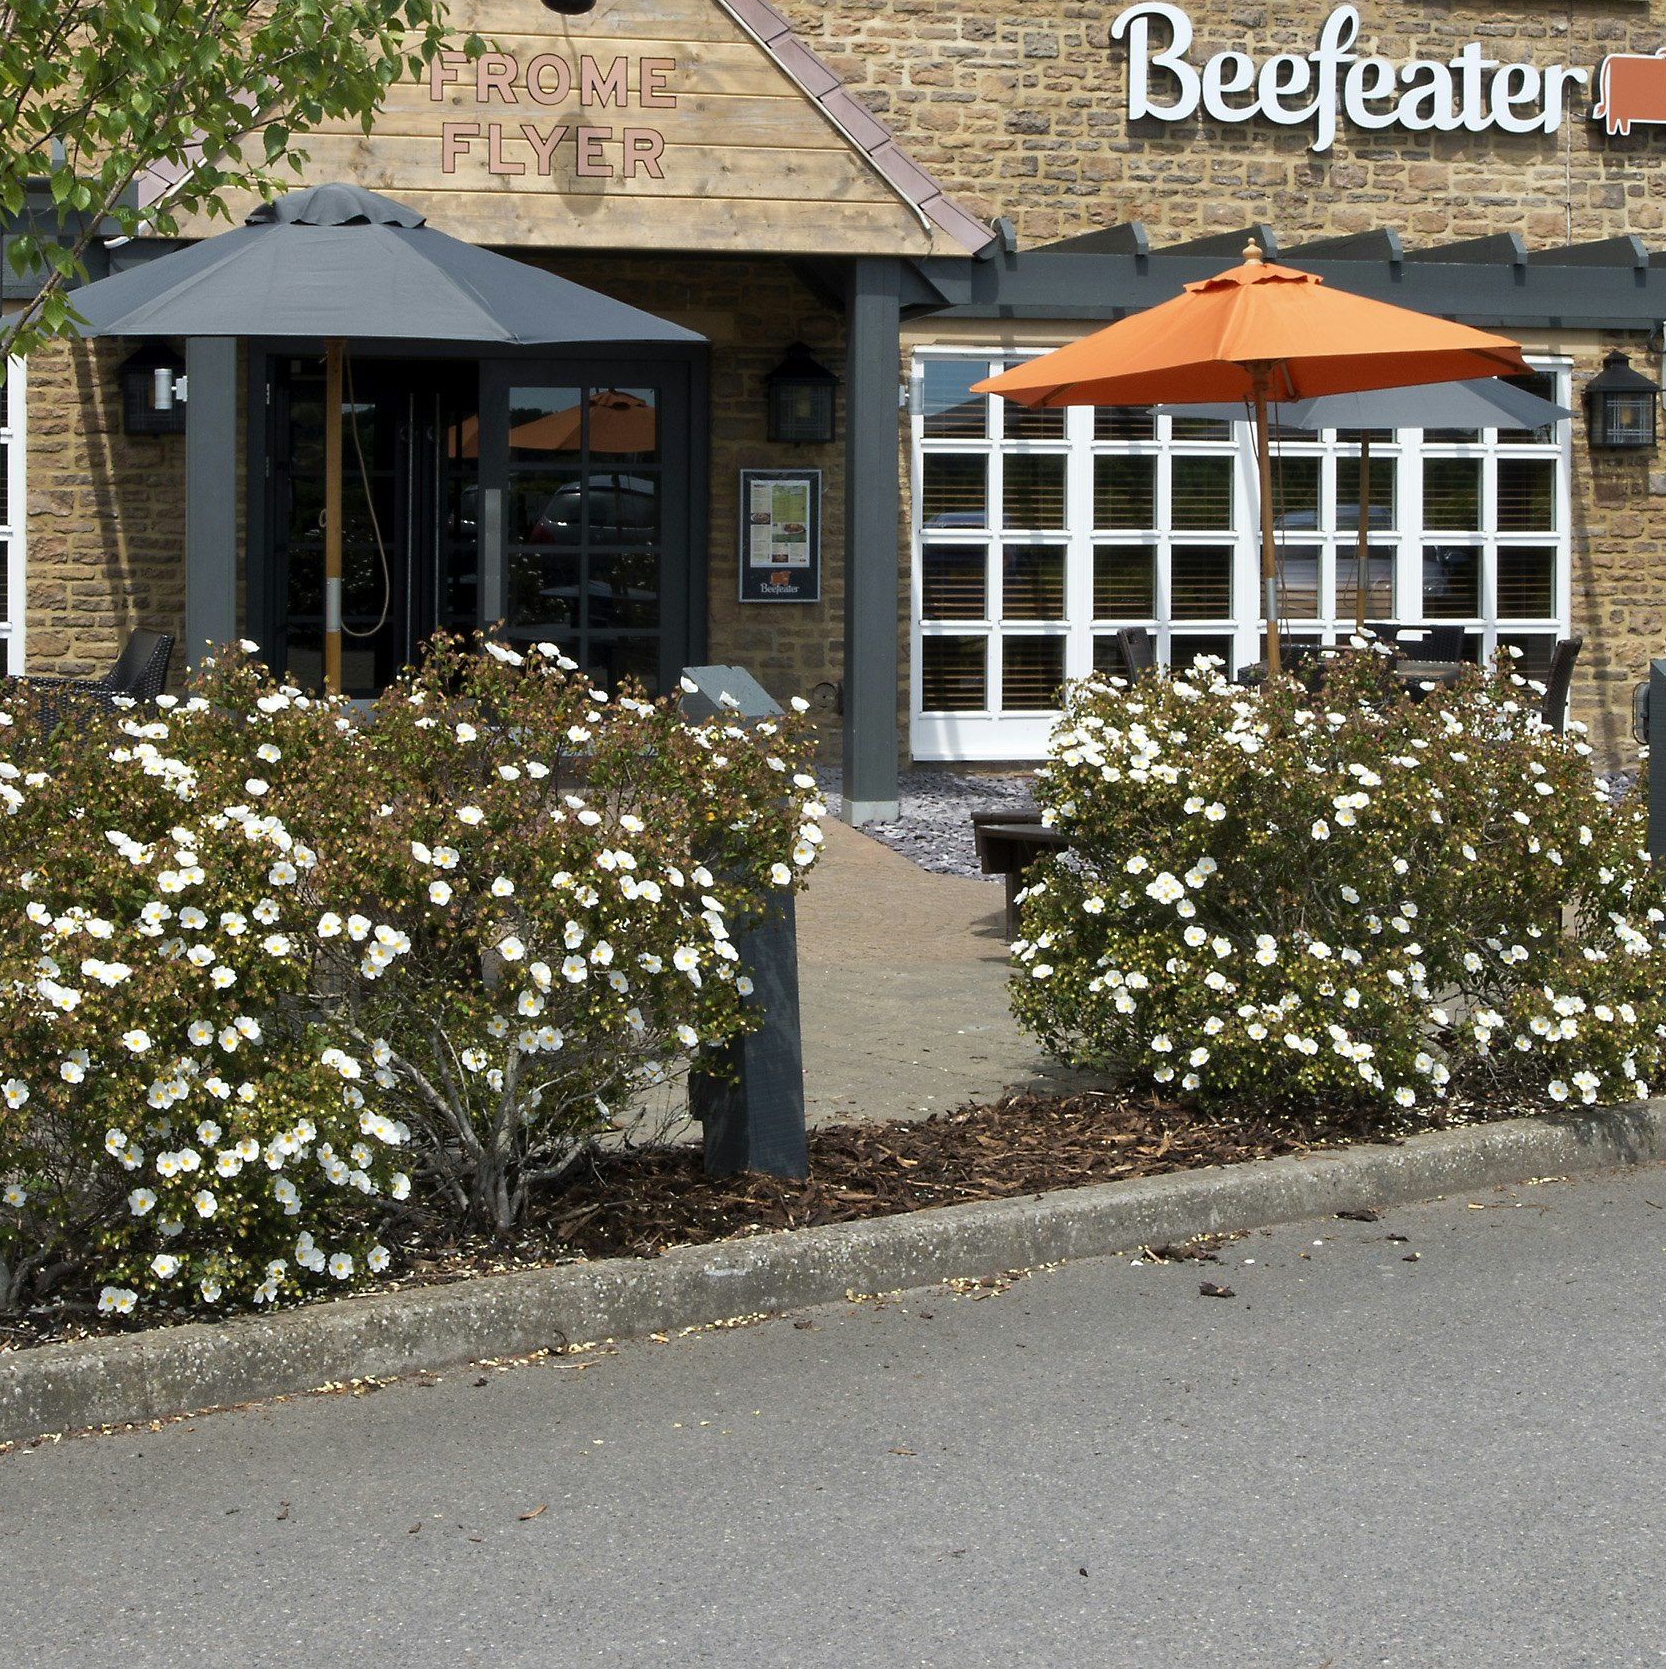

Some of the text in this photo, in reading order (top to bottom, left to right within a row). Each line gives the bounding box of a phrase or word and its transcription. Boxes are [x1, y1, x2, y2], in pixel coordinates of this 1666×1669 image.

[430, 50, 677, 108] FROME
[1111, 1, 1588, 152] Beefeater
[442, 122, 665, 178] FLYER
[760, 582, 800, 594] Beefeater
